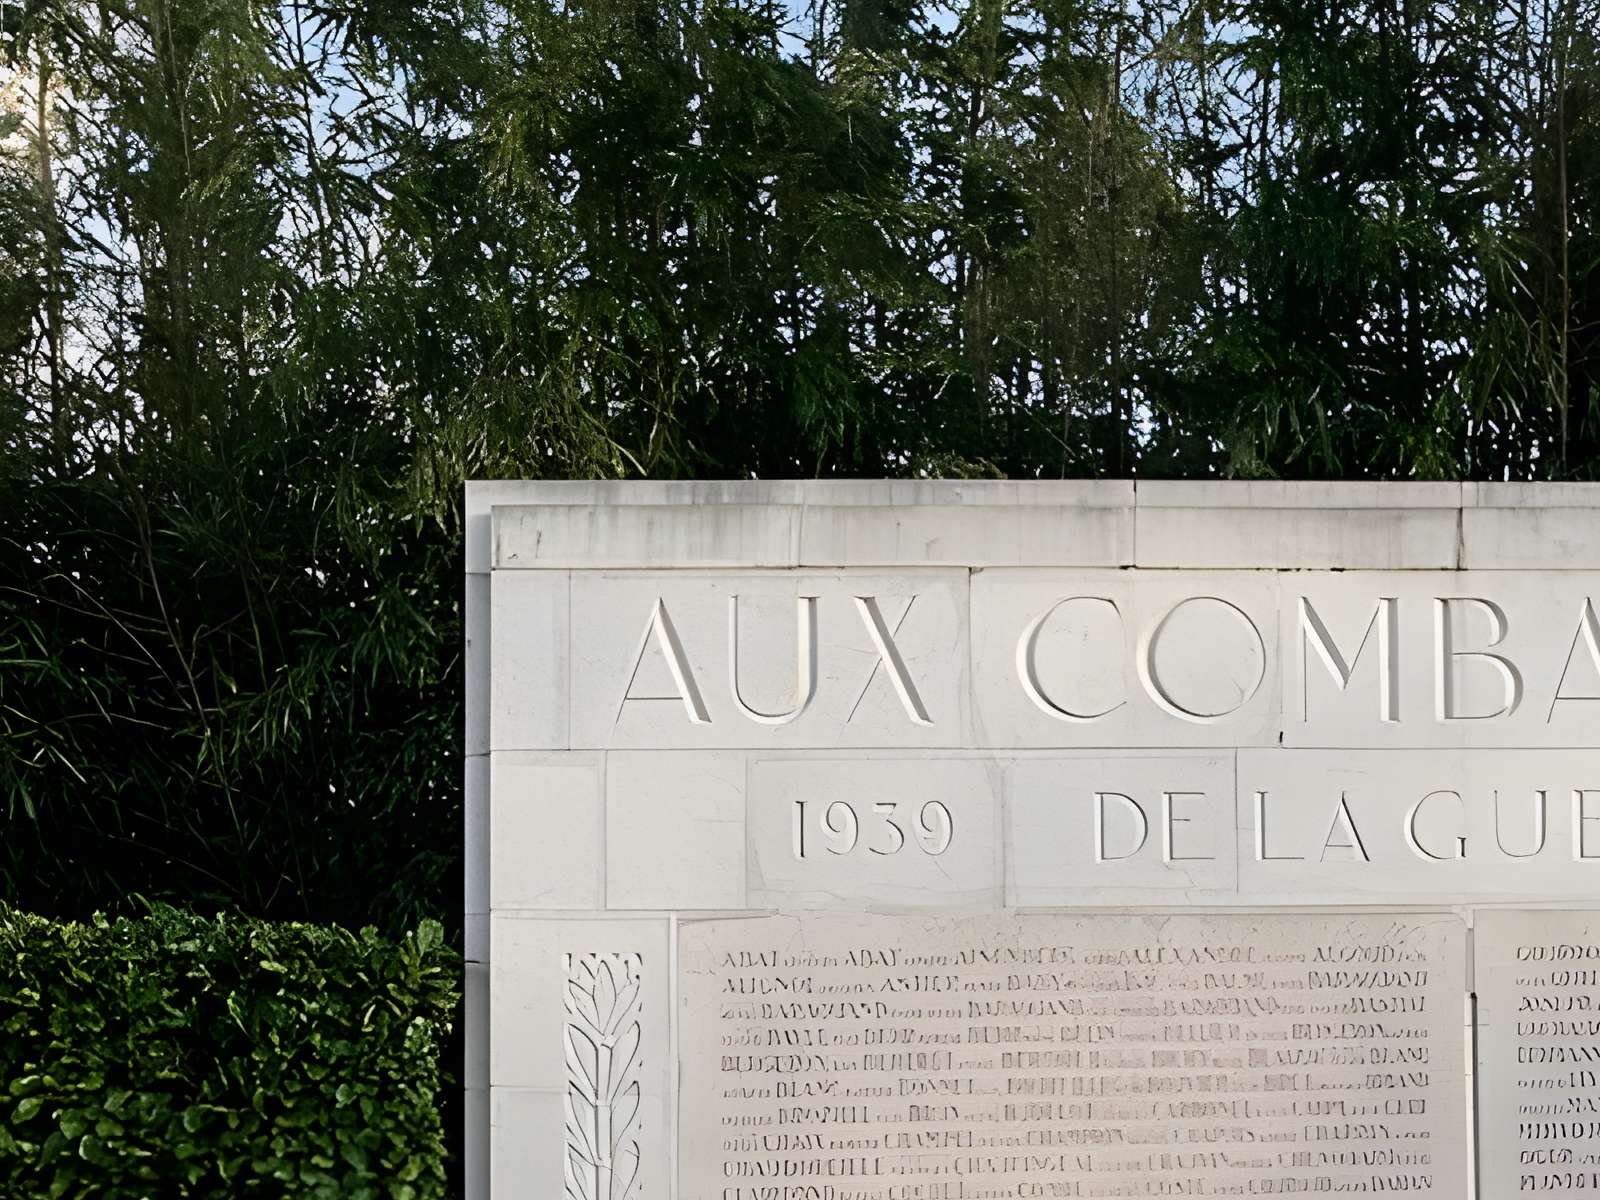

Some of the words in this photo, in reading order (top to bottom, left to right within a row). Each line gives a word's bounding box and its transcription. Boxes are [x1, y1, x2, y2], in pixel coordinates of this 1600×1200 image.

[613, 593, 935, 725] AUX
[792, 800, 955, 861] 1939
[1093, 790, 1217, 863] DE
[1253, 790, 1370, 863] LA
